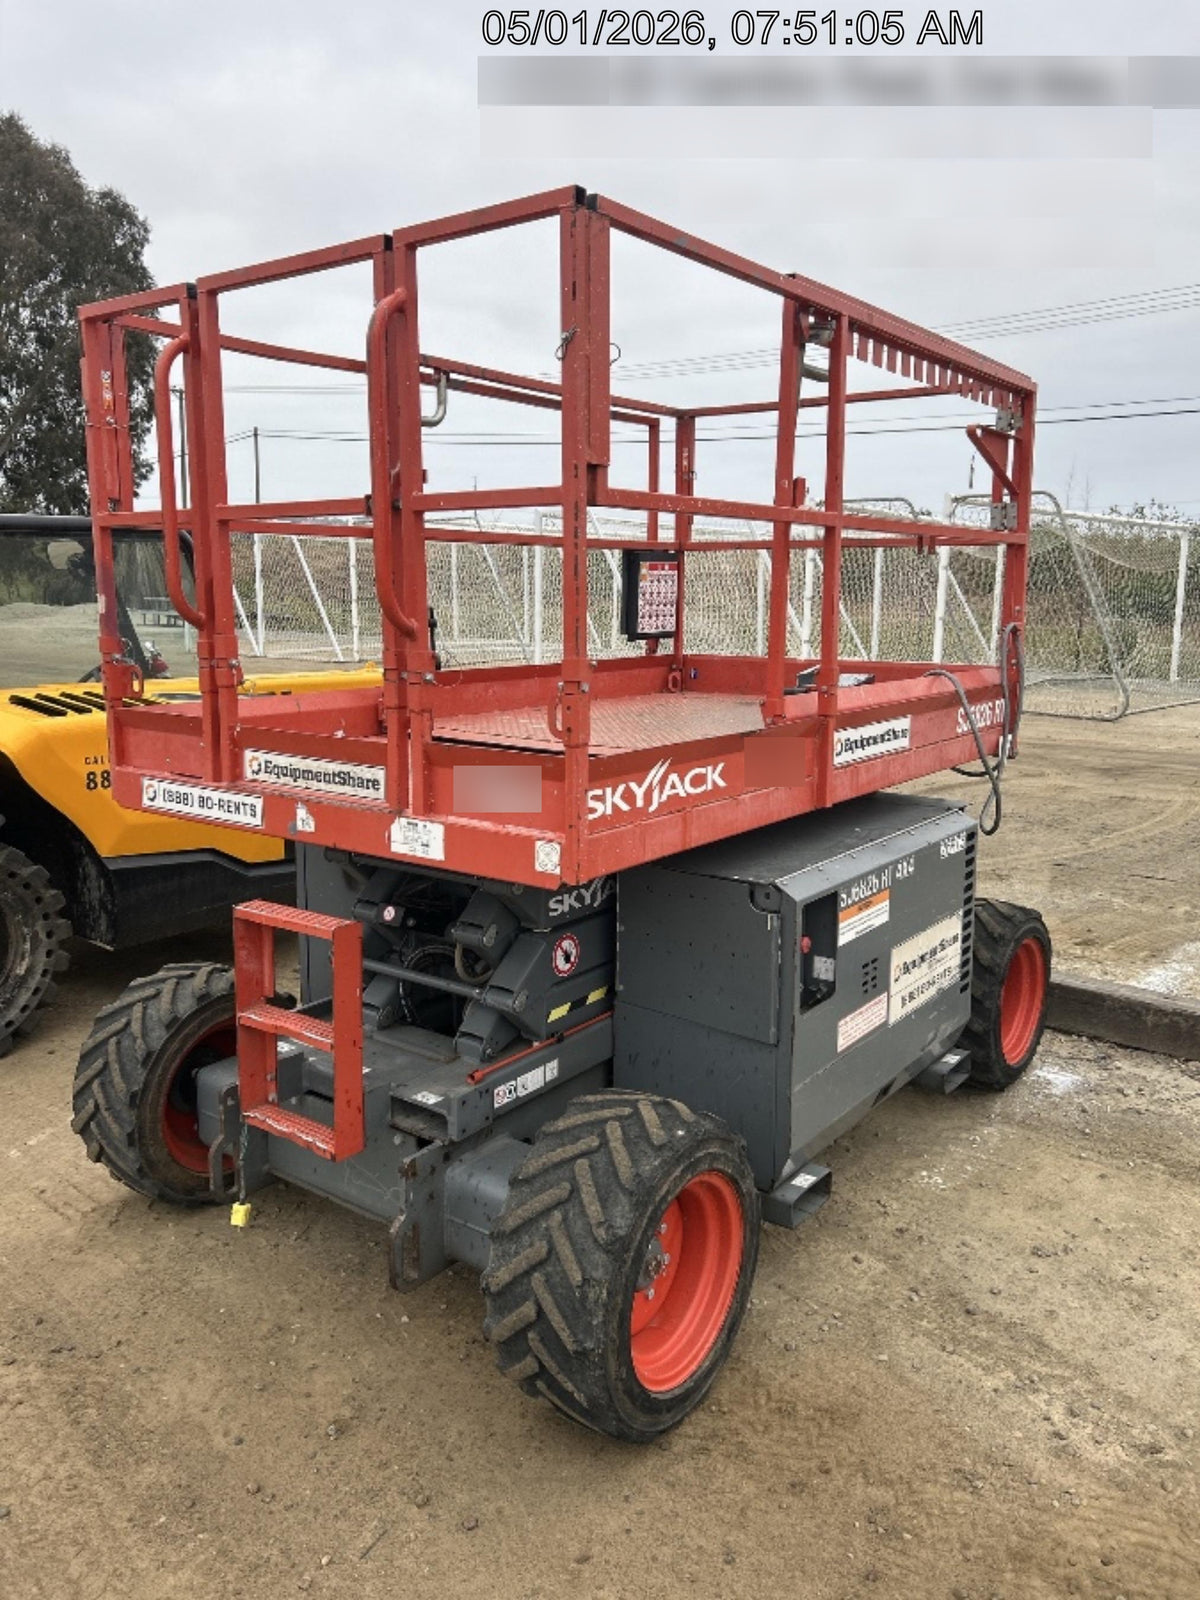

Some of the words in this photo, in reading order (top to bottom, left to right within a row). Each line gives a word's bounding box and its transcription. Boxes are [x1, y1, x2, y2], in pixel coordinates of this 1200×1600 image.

[84, 755, 105, 765] CAL
[263, 759, 382, 792] EquipmentShare
[86, 769, 111, 791] 88
[586, 757, 727, 820] SKYJACK
[162, 787, 194, 807] (888)
[198, 793, 257, 818] 80-RENTS
